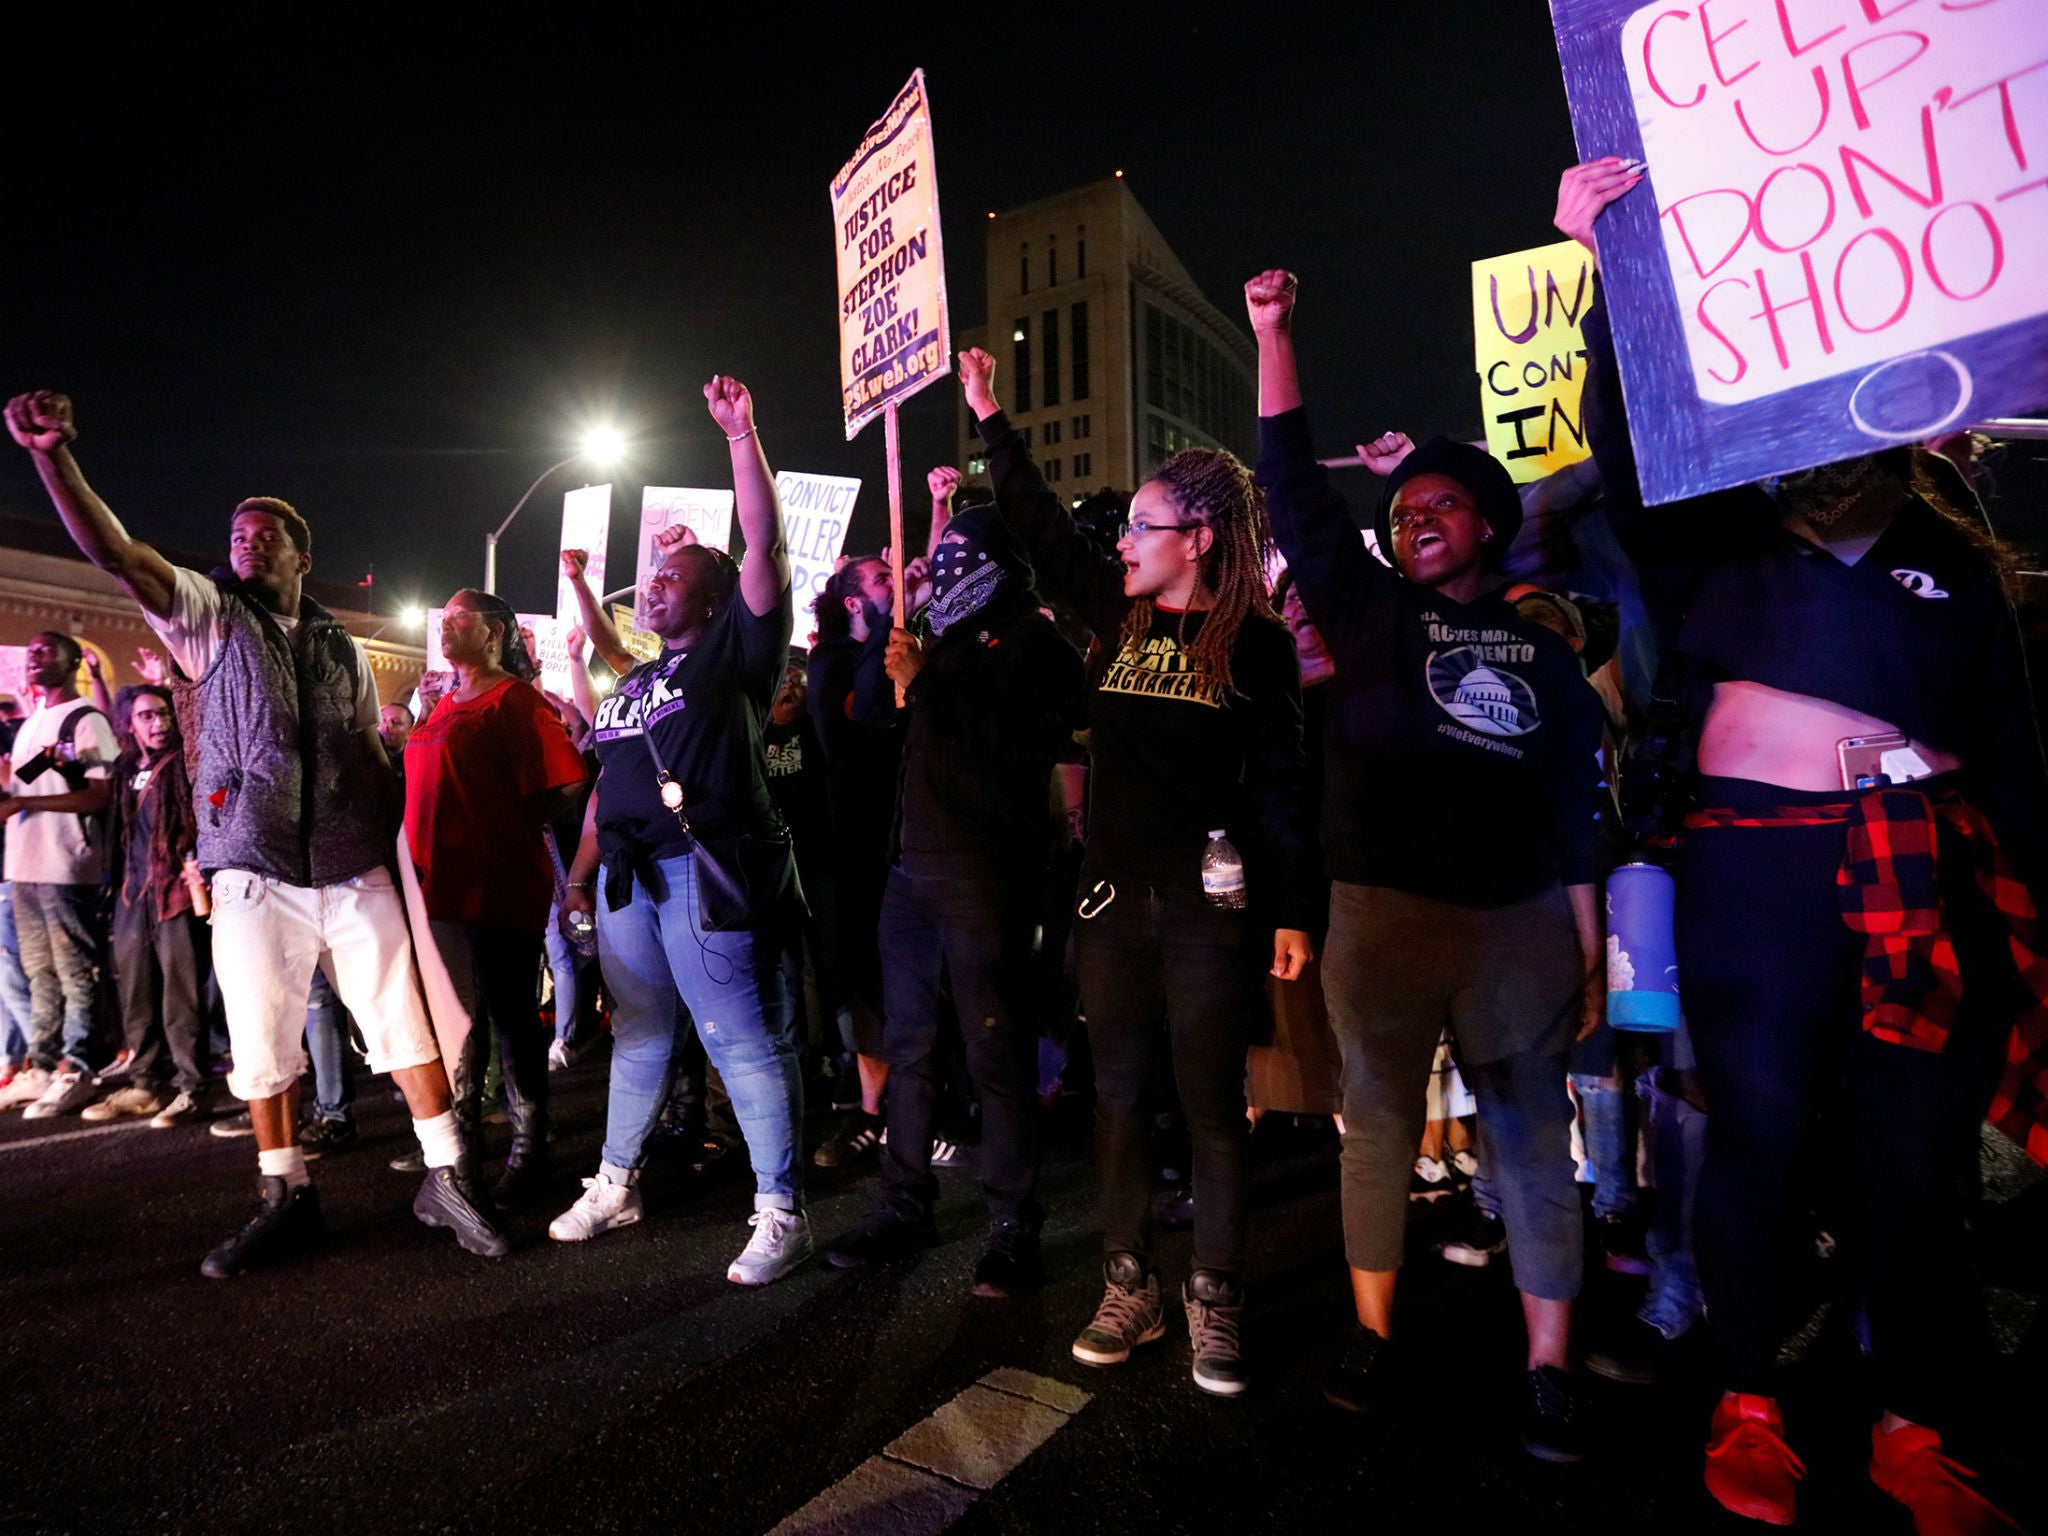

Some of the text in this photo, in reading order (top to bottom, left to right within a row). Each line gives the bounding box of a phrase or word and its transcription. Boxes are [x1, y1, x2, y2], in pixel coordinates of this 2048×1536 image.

[1734, 31, 1930, 156] UP
[844, 159, 916, 250] JUSTICE
[1659, 61, 2048, 279] DON'T
[843, 228, 927, 324] STEPHON
[858, 216, 896, 270] FOR
[851, 307, 919, 377] CLARK!
[778, 476, 857, 515] CONVICT
[785, 514, 842, 564] ILLER
